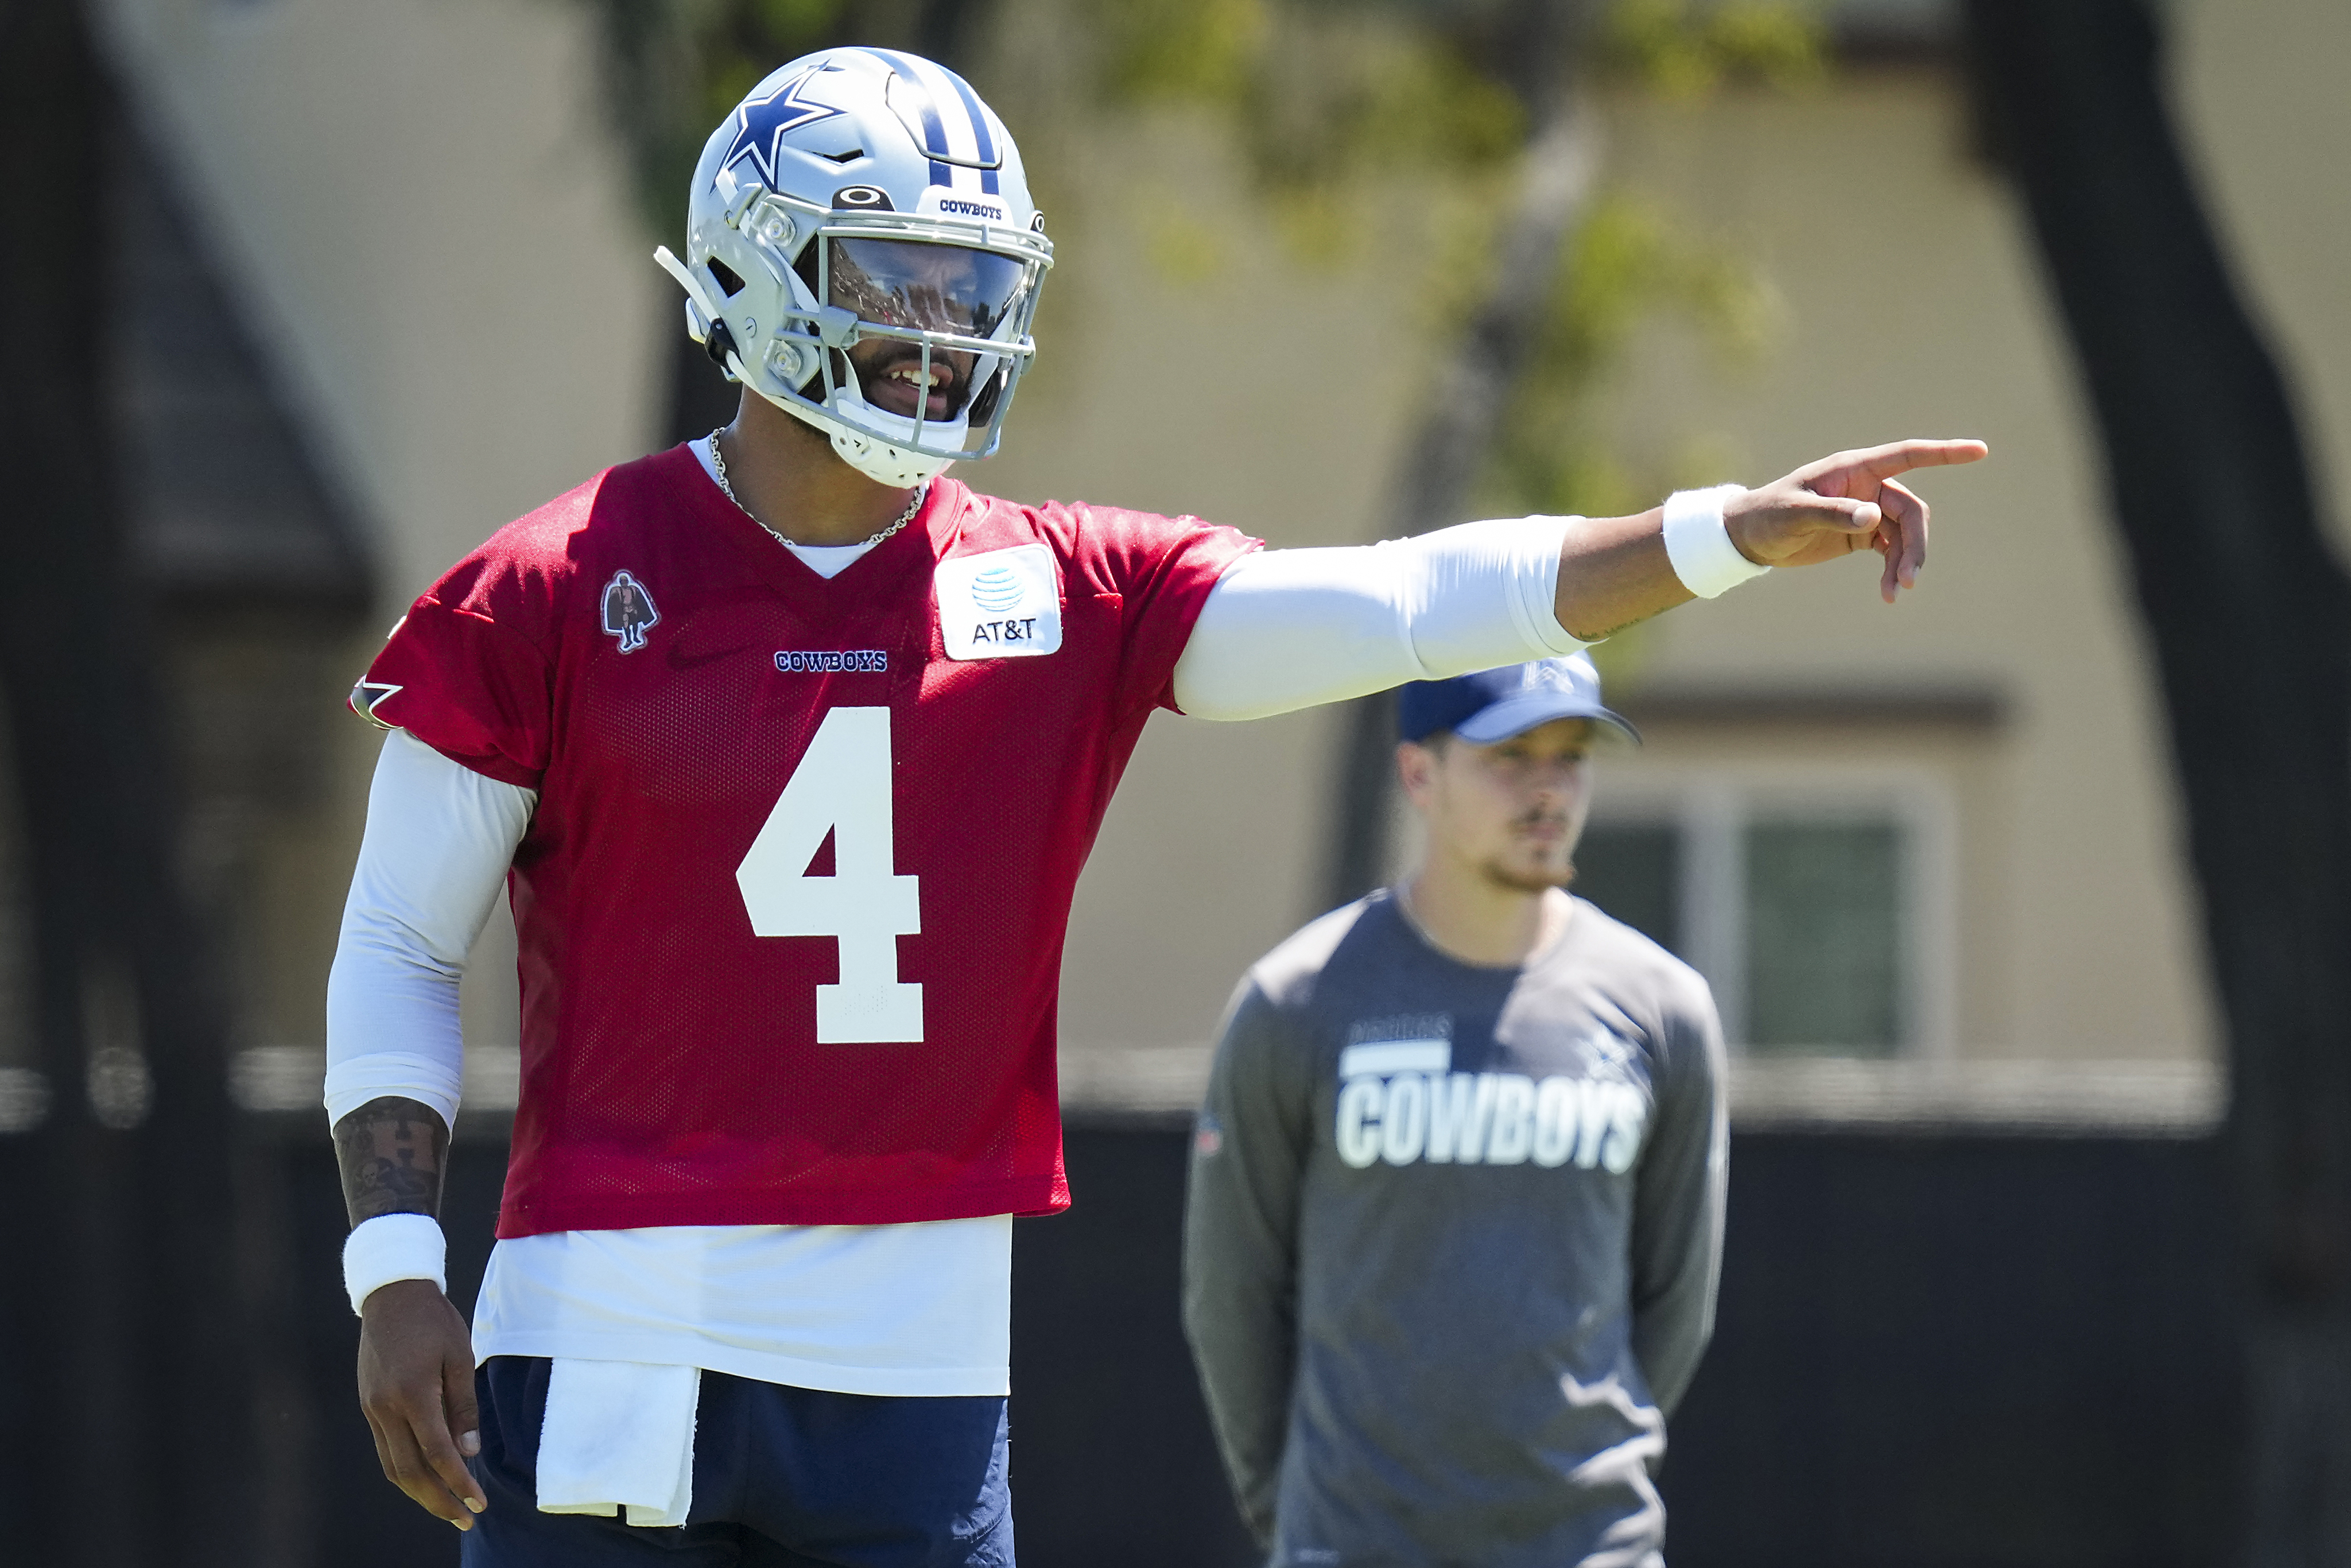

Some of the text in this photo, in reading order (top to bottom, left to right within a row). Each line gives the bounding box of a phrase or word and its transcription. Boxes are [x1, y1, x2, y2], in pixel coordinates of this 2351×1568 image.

[940, 199, 1002, 220] COWBOYS
[972, 617, 1037, 645] AT&T
[774, 650, 888, 672] COWBOYS
[735, 706, 924, 1044] 4
[1337, 1072, 1645, 1175] COWBOYS
